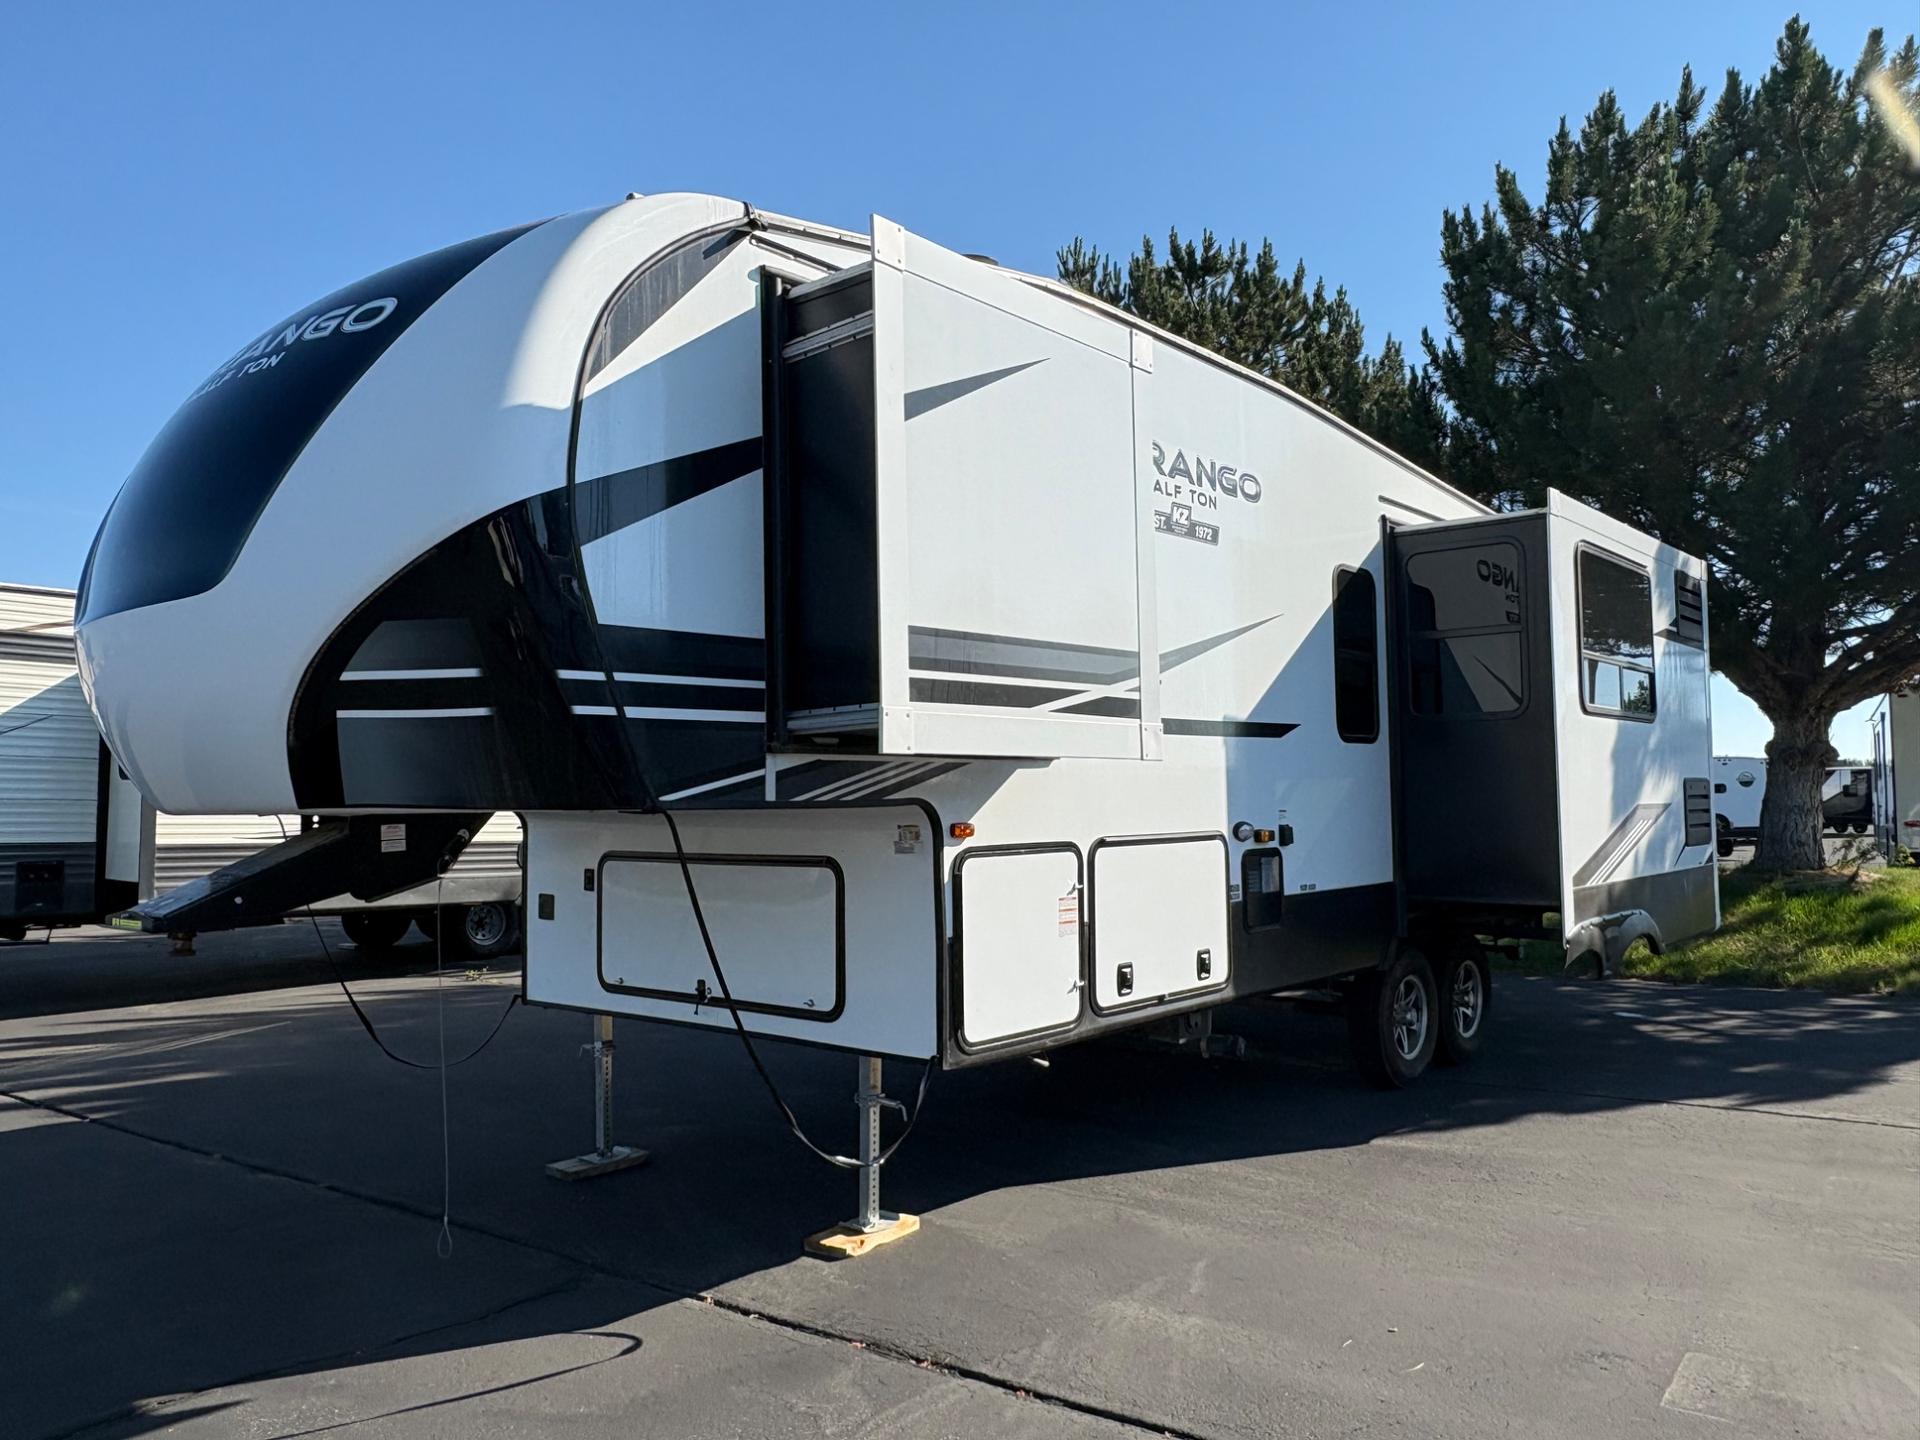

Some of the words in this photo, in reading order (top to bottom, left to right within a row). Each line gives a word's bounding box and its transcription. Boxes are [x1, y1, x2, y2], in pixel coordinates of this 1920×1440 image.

[224, 296, 398, 368] ANGO
[237, 351, 287, 378] TON
[1189, 489, 1217, 510] TON
[1172, 506, 1190, 525] KZ
[1194, 525, 1213, 541] 1972
